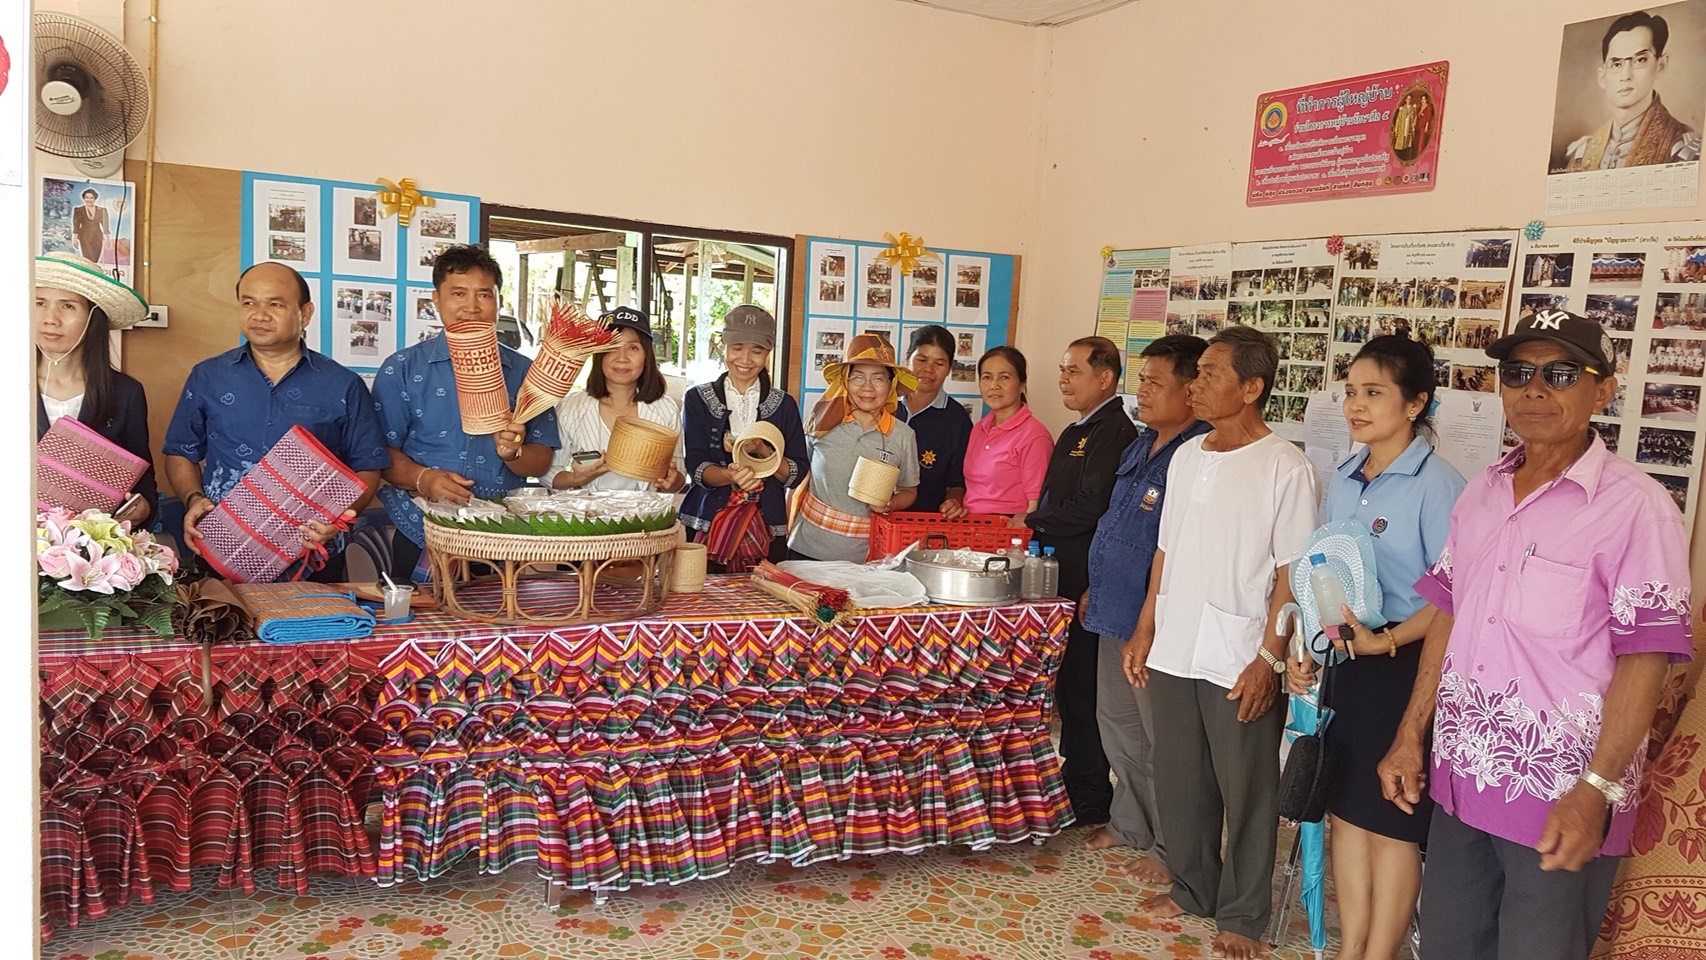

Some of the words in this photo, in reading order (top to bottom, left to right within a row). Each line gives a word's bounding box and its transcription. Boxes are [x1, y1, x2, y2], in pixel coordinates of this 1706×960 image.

[1296, 84, 1393, 114] ที่ทำการผู้ใหญ่บ้าน
[616, 311, 639, 322] CDD
[1529, 309, 1570, 331] NY
